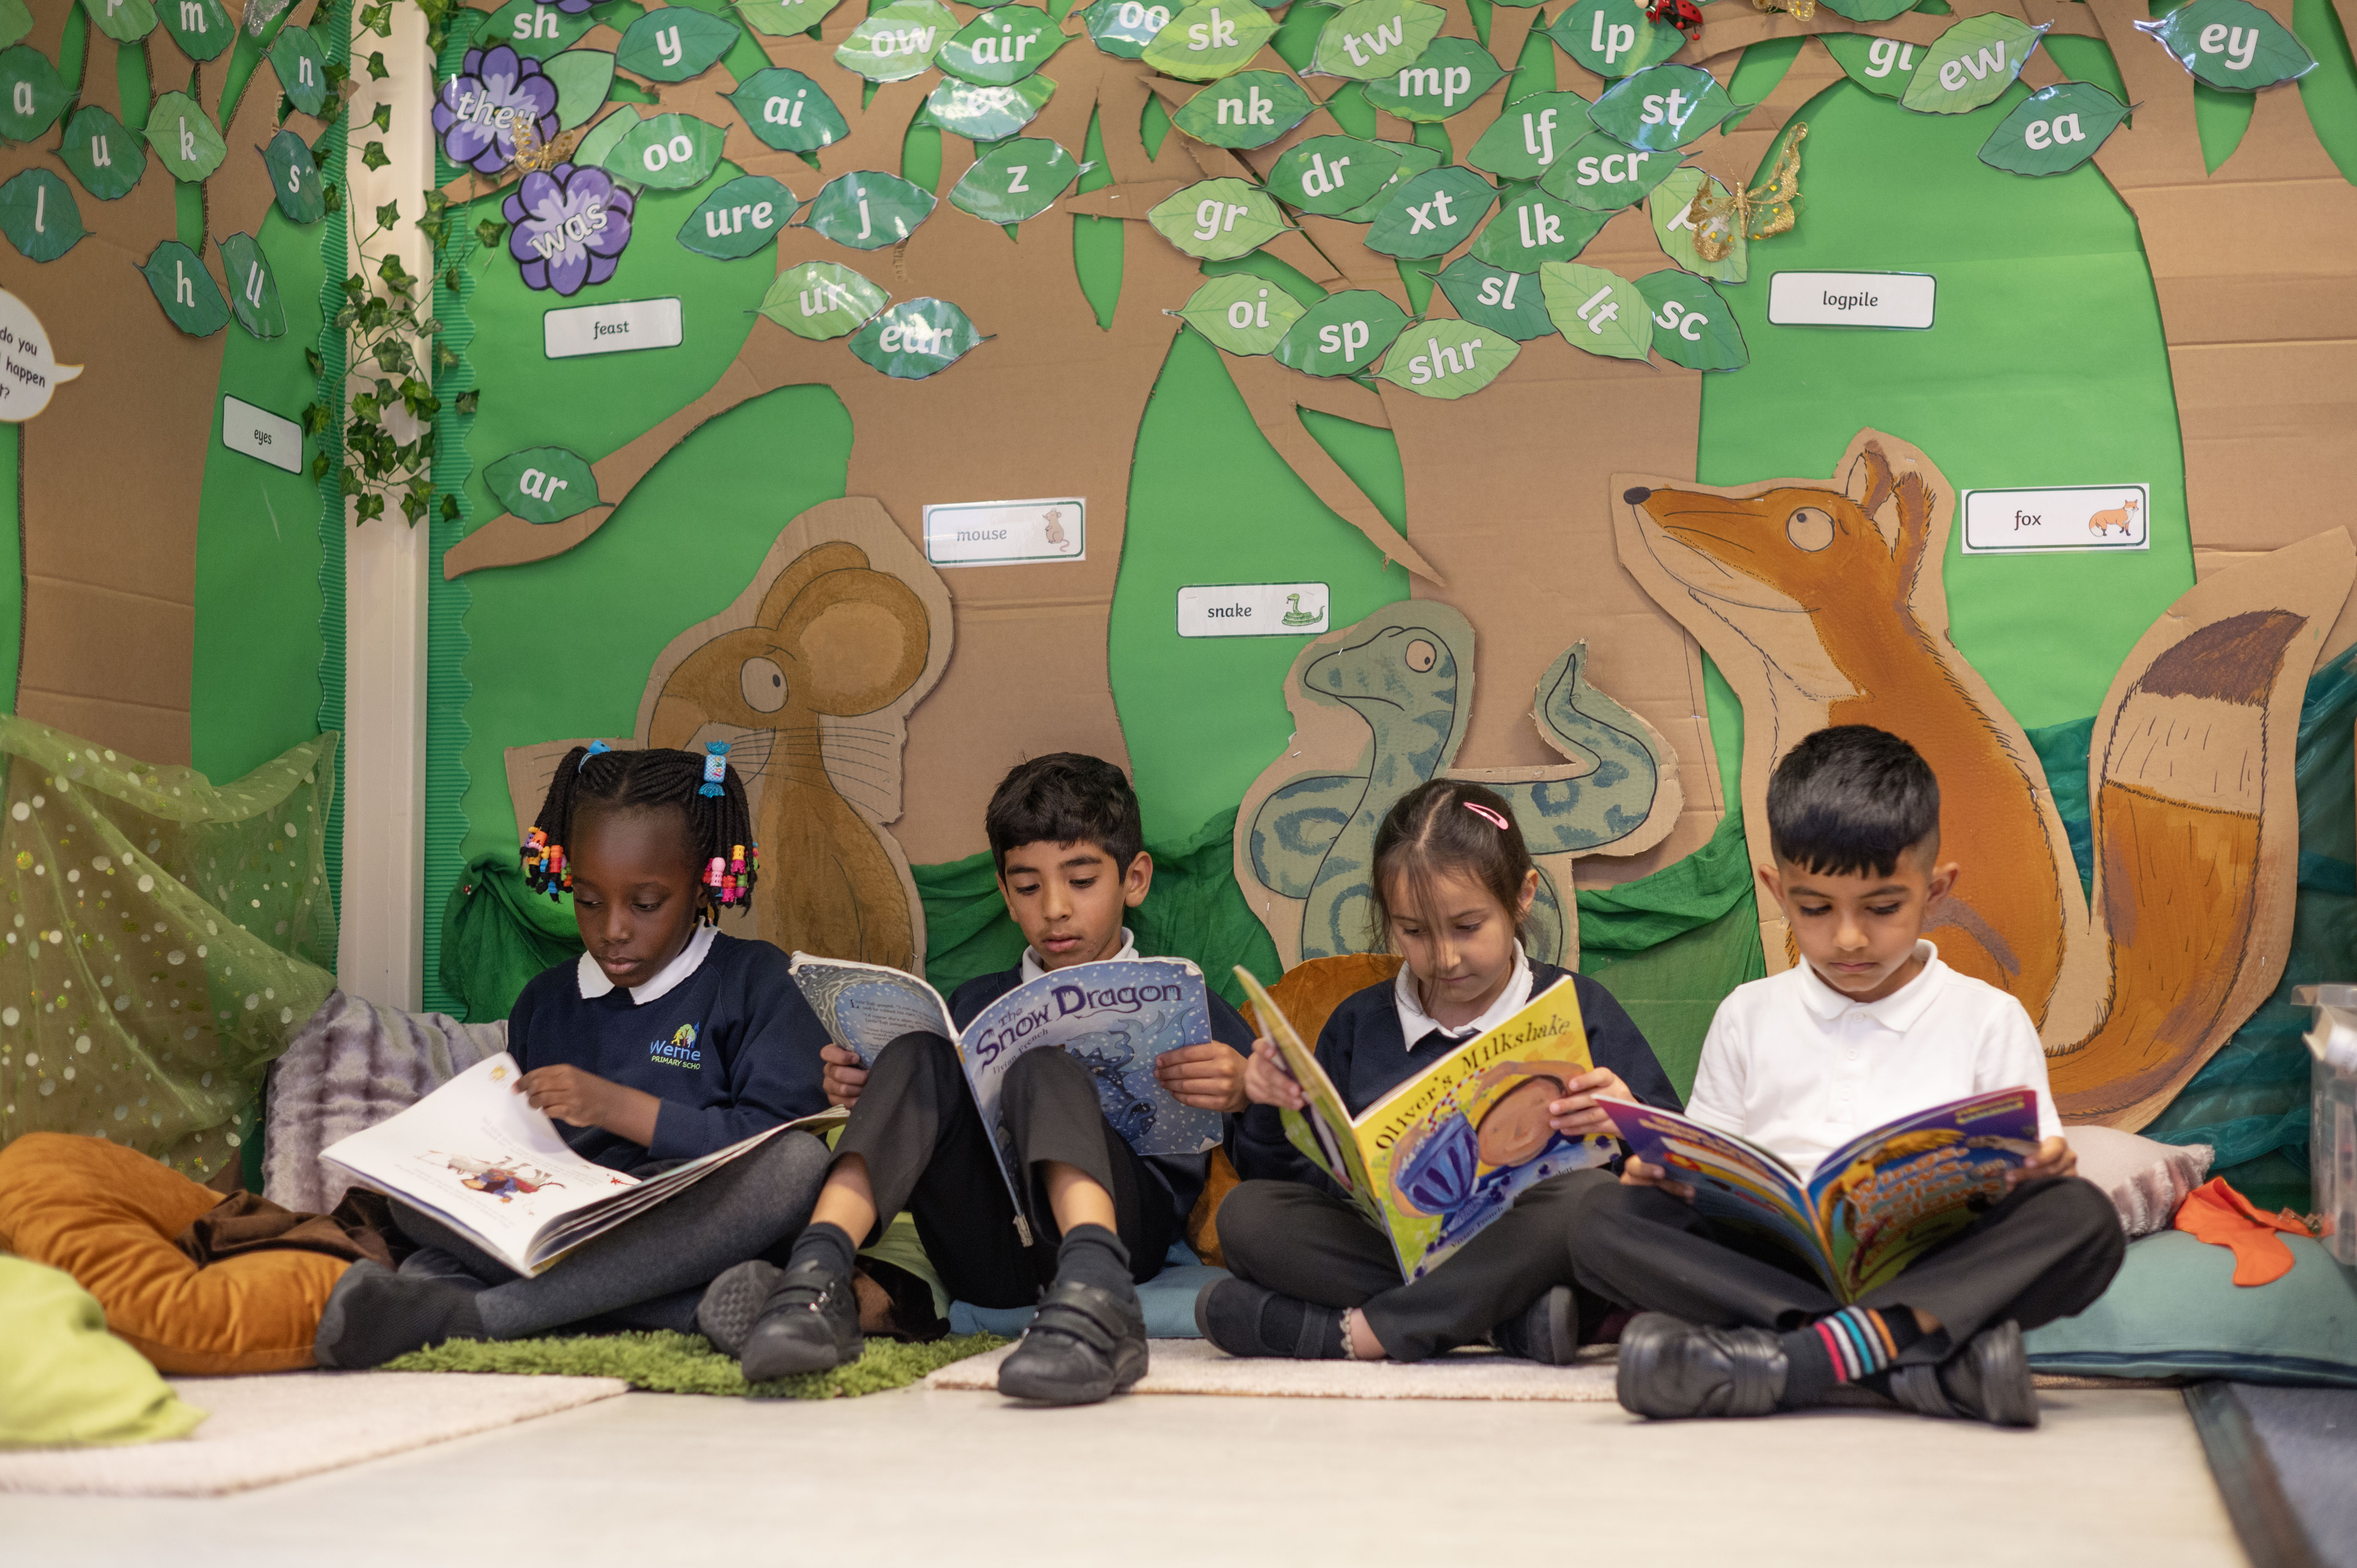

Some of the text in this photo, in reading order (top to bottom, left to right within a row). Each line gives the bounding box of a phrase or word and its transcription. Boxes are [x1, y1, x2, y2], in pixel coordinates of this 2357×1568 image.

[180, 1, 207, 33] m
[513, 5, 559, 39] sh
[1118, 1, 1170, 33] oo
[1188, 8, 1238, 50] sk
[656, 25, 682, 66] y
[870, 26, 936, 58] ow
[971, 23, 1036, 65] air
[1343, 16, 1403, 66] tw
[1591, 10, 1635, 64] lp
[2200, 24, 2259, 70] ey
[299, 56, 314, 87] n
[1940, 41, 2005, 91] ew
[13, 81, 35, 115] a
[1217, 86, 1274, 125] nk
[1399, 66, 1471, 107] mp
[763, 89, 806, 127] ai
[1640, 88, 1687, 126] st
[179, 116, 197, 161] k
[1523, 109, 1557, 165] lf
[2025, 113, 2086, 150] ea
[92, 135, 111, 167] u
[643, 135, 693, 171] oo
[1576, 152, 1649, 186] scr
[288, 164, 300, 193] s
[1007, 165, 1029, 193] z
[1302, 153, 1350, 197] dr
[35, 185, 45, 233] l
[705, 201, 774, 238] ure
[857, 187, 871, 240] j
[1193, 200, 1248, 240] gr
[1406, 190, 1458, 235] xt
[1518, 203, 1565, 248] lk
[531, 203, 609, 260] was
[177, 260, 195, 307] h
[246, 260, 265, 309] ll
[799, 283, 847, 317] ur
[1477, 272, 1520, 310] sl
[1823, 291, 1878, 310] logpile
[1228, 289, 1269, 328] oi
[1577, 285, 1619, 334] lt
[1656, 300, 1709, 341] sc
[0, 327, 37, 356] do you
[594, 321, 629, 340] feast
[879, 324, 953, 355] ear
[1319, 320, 1369, 362] sp
[5, 356, 46, 388] happen
[1409, 338, 1482, 384] shr
[254, 429, 272, 445] eyes
[519, 468, 568, 502] ar
[957, 530, 1007, 542] mouse
[2014, 510, 2041, 531] fox
[1208, 603, 1252, 618] snake
[976, 984, 1184, 1076] Snow Dragon
[998, 1007, 1023, 1028] The
[650, 1040, 700, 1061] Werne
[652, 1055, 682, 1067] PRIMARY
[1376, 1014, 1571, 1150] Oliver's Milkshake
